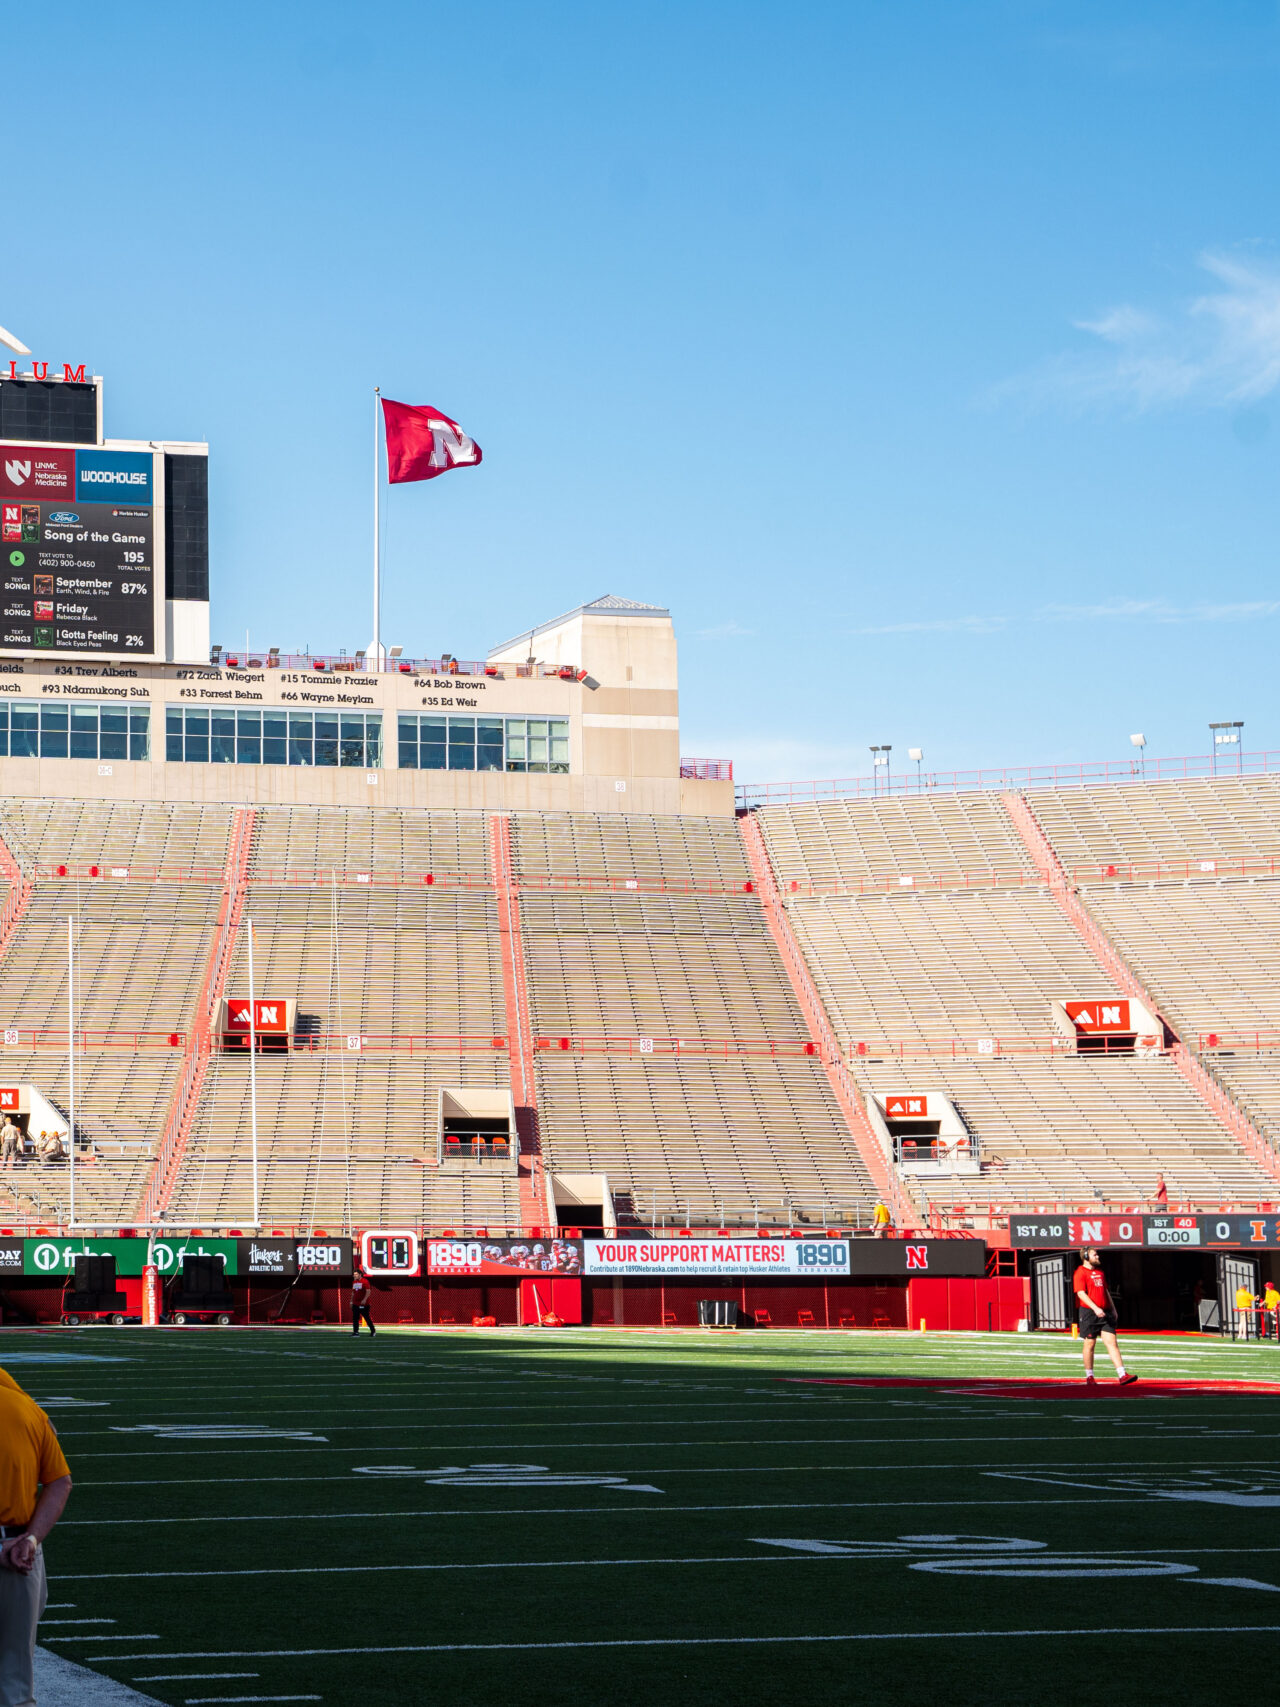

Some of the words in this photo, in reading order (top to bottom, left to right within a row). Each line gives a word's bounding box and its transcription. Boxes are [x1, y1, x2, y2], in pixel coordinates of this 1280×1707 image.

[35, 472, 67, 480] Nebraska
[81, 470, 147, 485] WOODHOUSE
[44, 530, 74, 542] Song
[76, 530, 88, 540] of
[91, 532, 109, 542] the
[112, 532, 146, 544] Game
[123, 552, 144, 563] 195
[60, 560, 96, 568] 900-0450
[56, 577, 112, 589] September
[121, 583, 148, 594] 87%
[56, 604, 88, 614] Friday
[62, 630, 86, 640] Gotta
[88, 630, 118, 643] Feeling
[125, 635, 144, 646] 2%
[176, 670, 194, 680] #72
[196, 670, 222, 681] Zach
[226, 672, 265, 684] Wiegert
[280, 674, 298, 684] #15
[301, 674, 342, 685] Tommie
[344, 676, 378, 686] Frazier
[42, 684, 60, 694] #93
[63, 684, 128, 698] Ndamukong
[130, 686, 150, 697] Suh
[180, 688, 198, 698] #33
[200, 688, 232, 699] Forrest
[235, 690, 263, 700] Behm
[422, 696, 439, 706] #35
[441, 697, 454, 706] Ed
[457, 697, 478, 708] Weir
[261, 1006, 278, 1024] N
[1102, 1006, 1122, 1024] N
[6, 1031, 16, 1042] 36
[350, 1038, 359, 1048] 37
[642, 1040, 652, 1051] 38
[1154, 1219, 1168, 1227] 1ST
[1178, 1218, 1192, 1228] 40
[1016, 1226, 1038, 1237] 1ST
[1040, 1228, 1048, 1236] &
[1049, 1226, 1062, 1237] 10
[1081, 1221, 1102, 1242] N
[1119, 1222, 1132, 1240] 0
[1158, 1231, 1190, 1243] 0:00
[1216, 1222, 1230, 1240] 0
[296, 1246, 341, 1265] 1890
[372, 1238, 409, 1267] 40
[428, 1243, 482, 1266] 1890
[596, 1244, 637, 1262] YOUR
[640, 1244, 708, 1262] SUPPORT
[712, 1244, 785, 1262] MATTERS!
[796, 1244, 847, 1266] 1890
[905, 1245, 928, 1268] N
